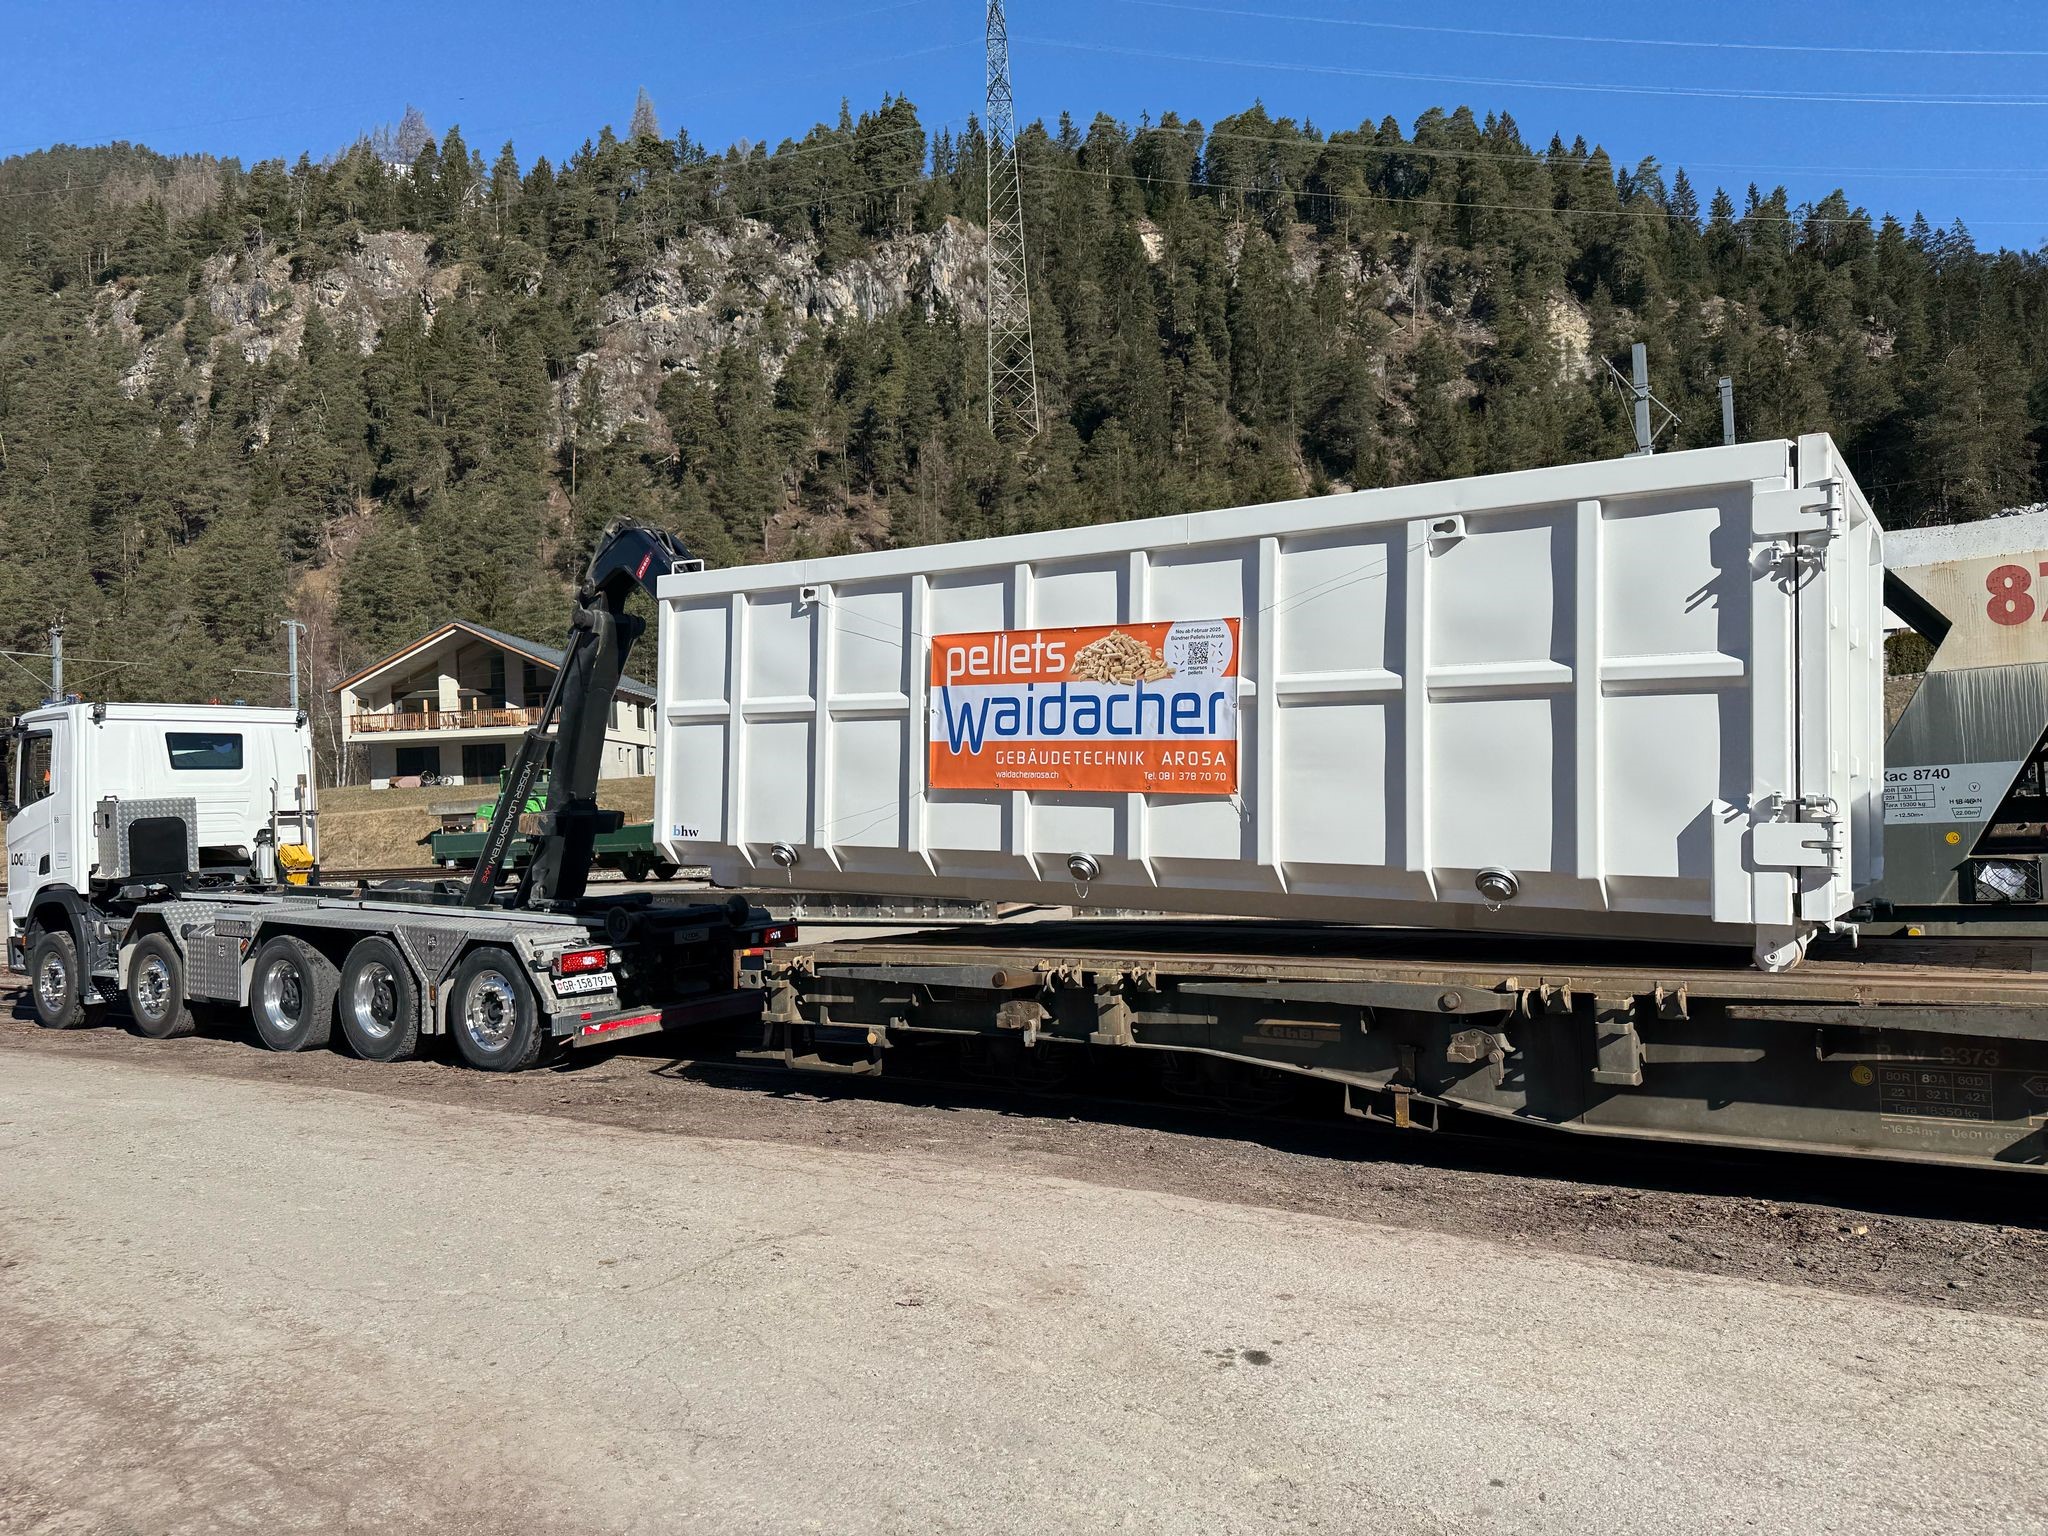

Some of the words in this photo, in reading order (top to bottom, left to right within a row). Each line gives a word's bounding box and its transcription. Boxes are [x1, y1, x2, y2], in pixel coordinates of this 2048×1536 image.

[1985, 561, 2048, 626] 8
[946, 632, 1067, 686] pellets
[942, 680, 1226, 755] Waidacher
[995, 748, 1145, 766] GEBÄUDETECHNIK
[1161, 751, 1227, 767] AROSA
[514, 760, 534, 800] MOSER
[995, 770, 1059, 779] waidacherarosa.ch
[1143, 771, 1157, 780] Tel.
[1158, 772, 1175, 781] 081
[1178, 772, 1197, 781] 378
[1200, 772, 1212, 781] 70
[1215, 772, 1228, 781] 70
[1913, 768, 1950, 780] 8740
[489, 799, 520, 865] LOADSYSTEM
[673, 825, 699, 837] bhw
[1921, 1073, 1948, 1084] 80A
[1894, 1104, 1918, 1115] Tara
[1965, 1108, 1981, 1120] kg
